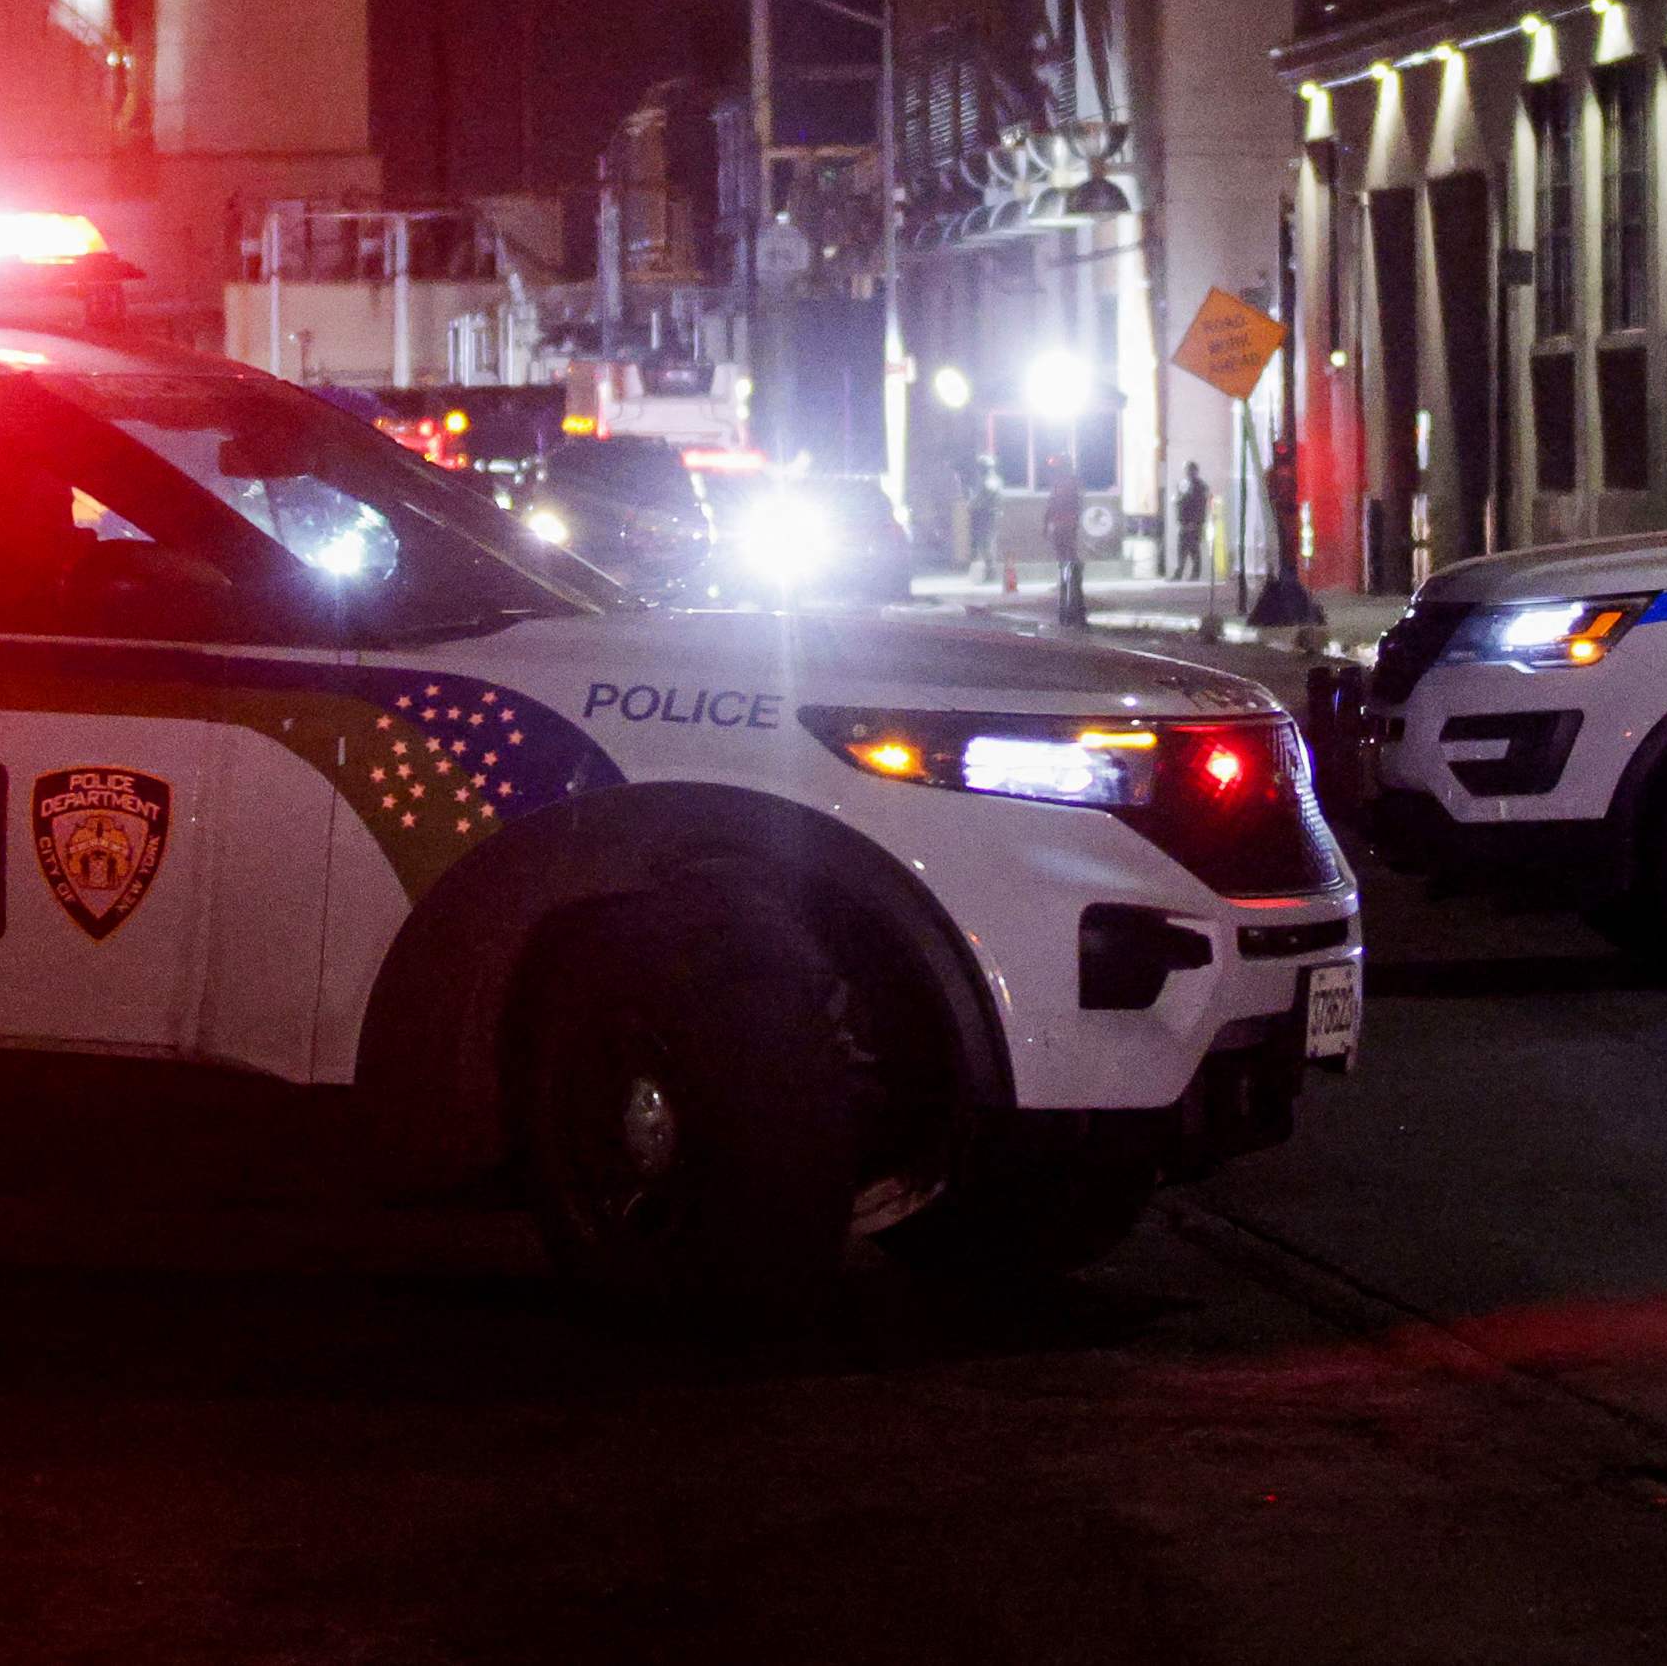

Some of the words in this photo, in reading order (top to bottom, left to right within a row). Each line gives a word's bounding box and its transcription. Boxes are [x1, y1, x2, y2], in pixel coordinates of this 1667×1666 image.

[583, 683, 785, 730] POLICE
[68, 773, 137, 794] POLICE
[40, 789, 161, 822] DEPARTMENT
[38, 835, 63, 878] CITY
